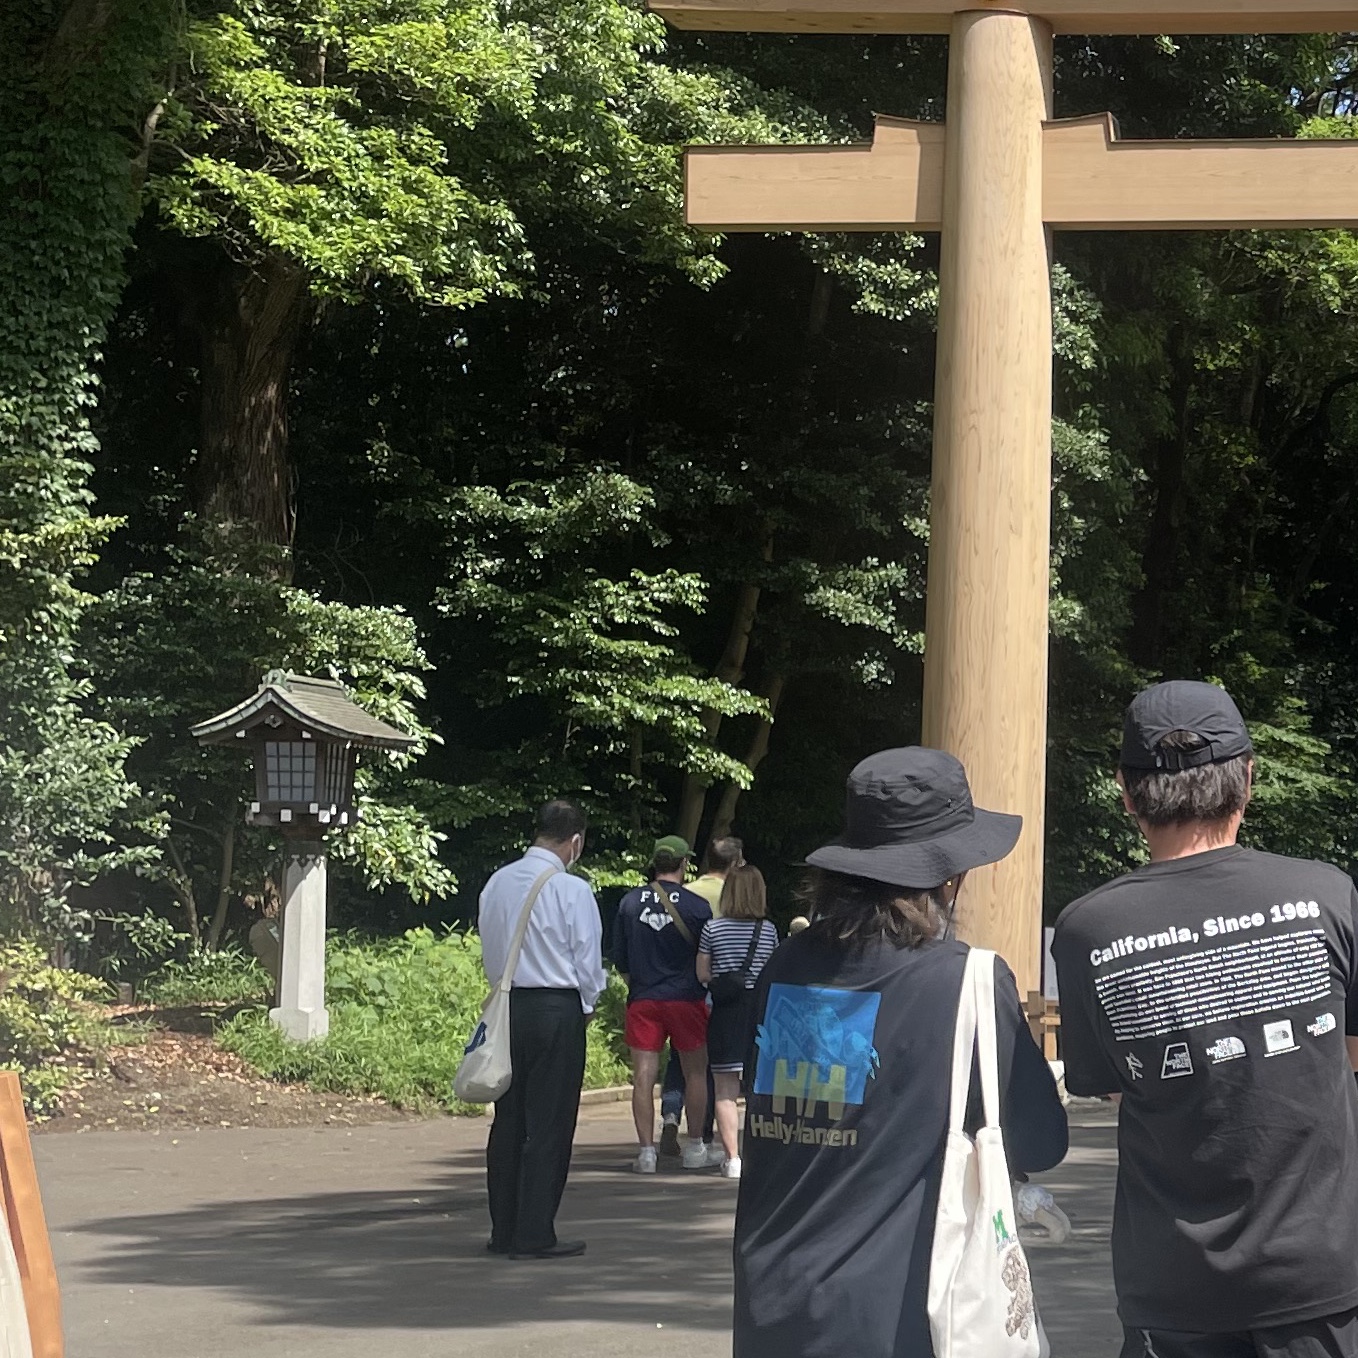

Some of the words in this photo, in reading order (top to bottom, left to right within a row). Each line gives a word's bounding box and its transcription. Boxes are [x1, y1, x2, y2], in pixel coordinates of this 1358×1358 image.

[640, 890, 680, 903] FC
[1090, 926, 1200, 967] California,
[1203, 911, 1265, 937] Since
[1269, 900, 1321, 923] 1966
[773, 1059, 846, 1120] HH
